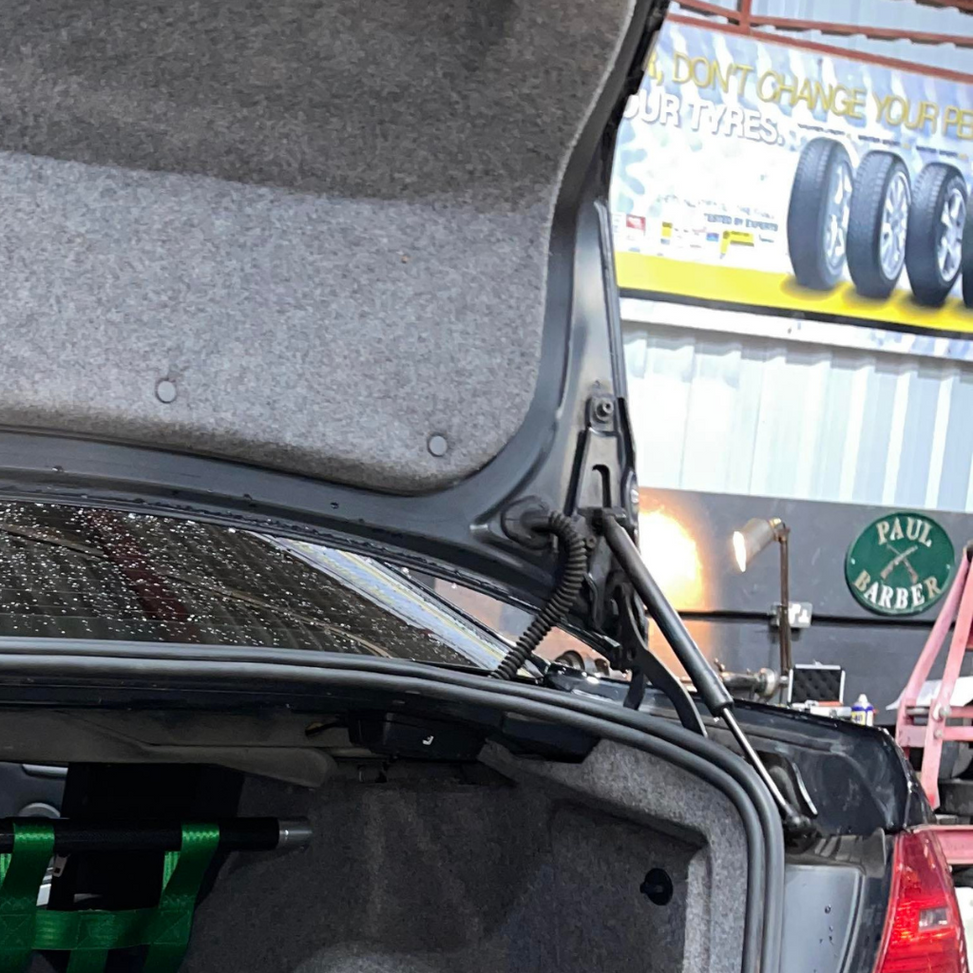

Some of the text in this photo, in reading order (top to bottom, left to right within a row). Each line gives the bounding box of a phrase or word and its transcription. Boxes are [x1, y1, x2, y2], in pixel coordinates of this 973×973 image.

[672, 51, 754, 95] DON'T
[757, 70, 868, 120] CHANGE
[872, 92, 939, 135] YOUR
[684, 98, 786, 147] TYRES.
[876, 517, 933, 547] PAUL
[853, 569, 942, 609] BARBER
